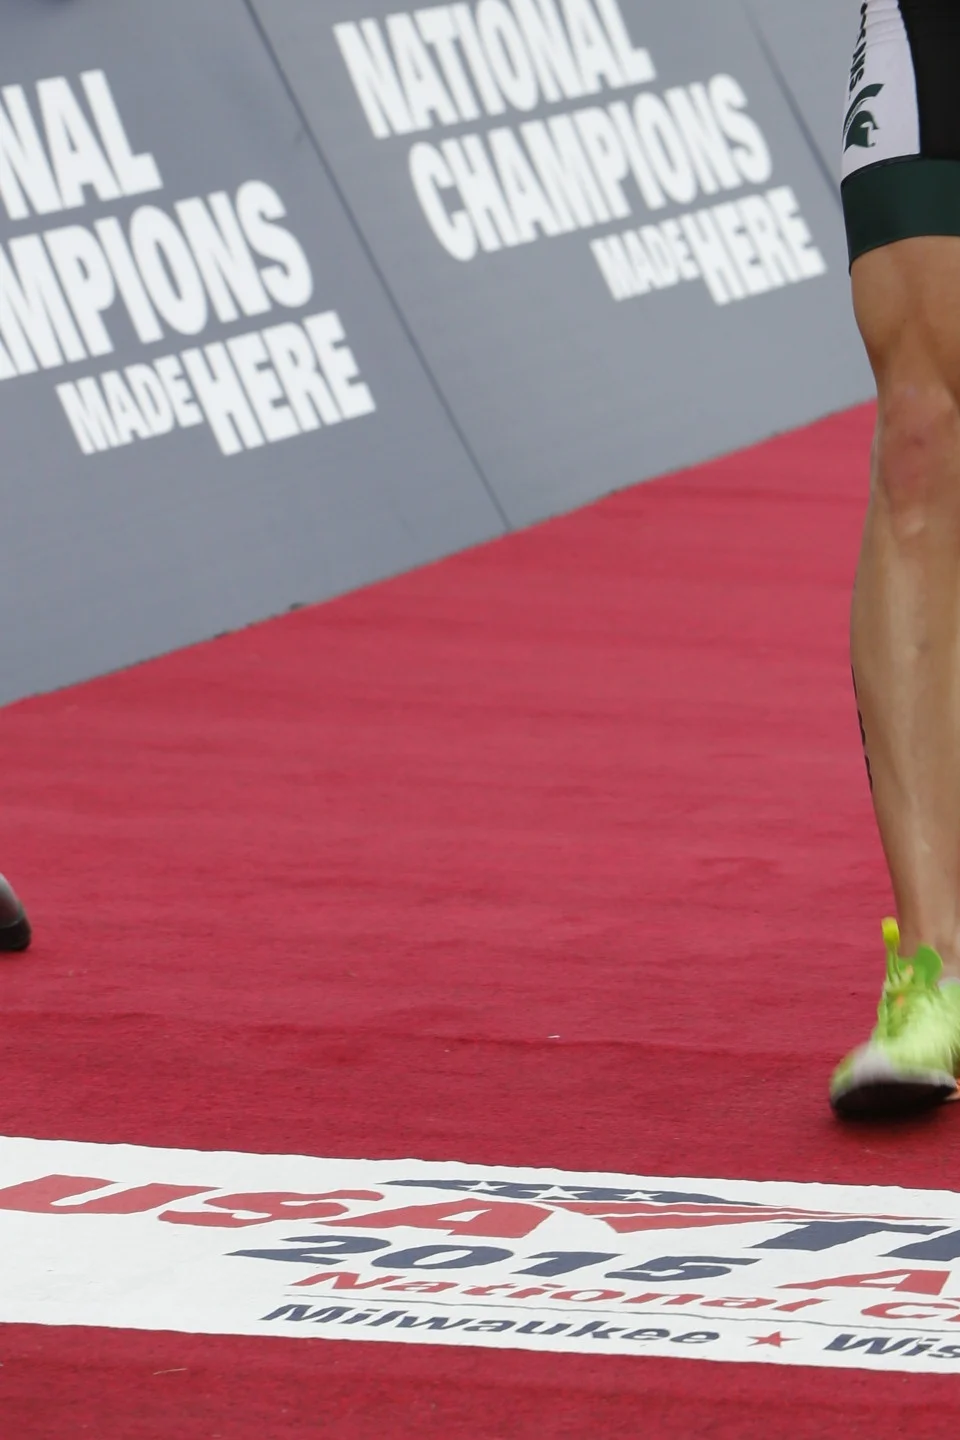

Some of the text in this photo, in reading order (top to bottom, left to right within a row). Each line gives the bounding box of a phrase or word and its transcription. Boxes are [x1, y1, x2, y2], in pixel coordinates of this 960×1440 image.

[409, 74, 772, 262] CHAMPIONS
[591, 186, 827, 305] MADE HERE
[55, 310, 376, 456] MADE HERE
[0, 1174, 555, 1238] USA
[223, 1235, 762, 1281] 2015
[257, 1304, 720, 1344] Milwaukee
[287, 1272, 831, 1312] National
